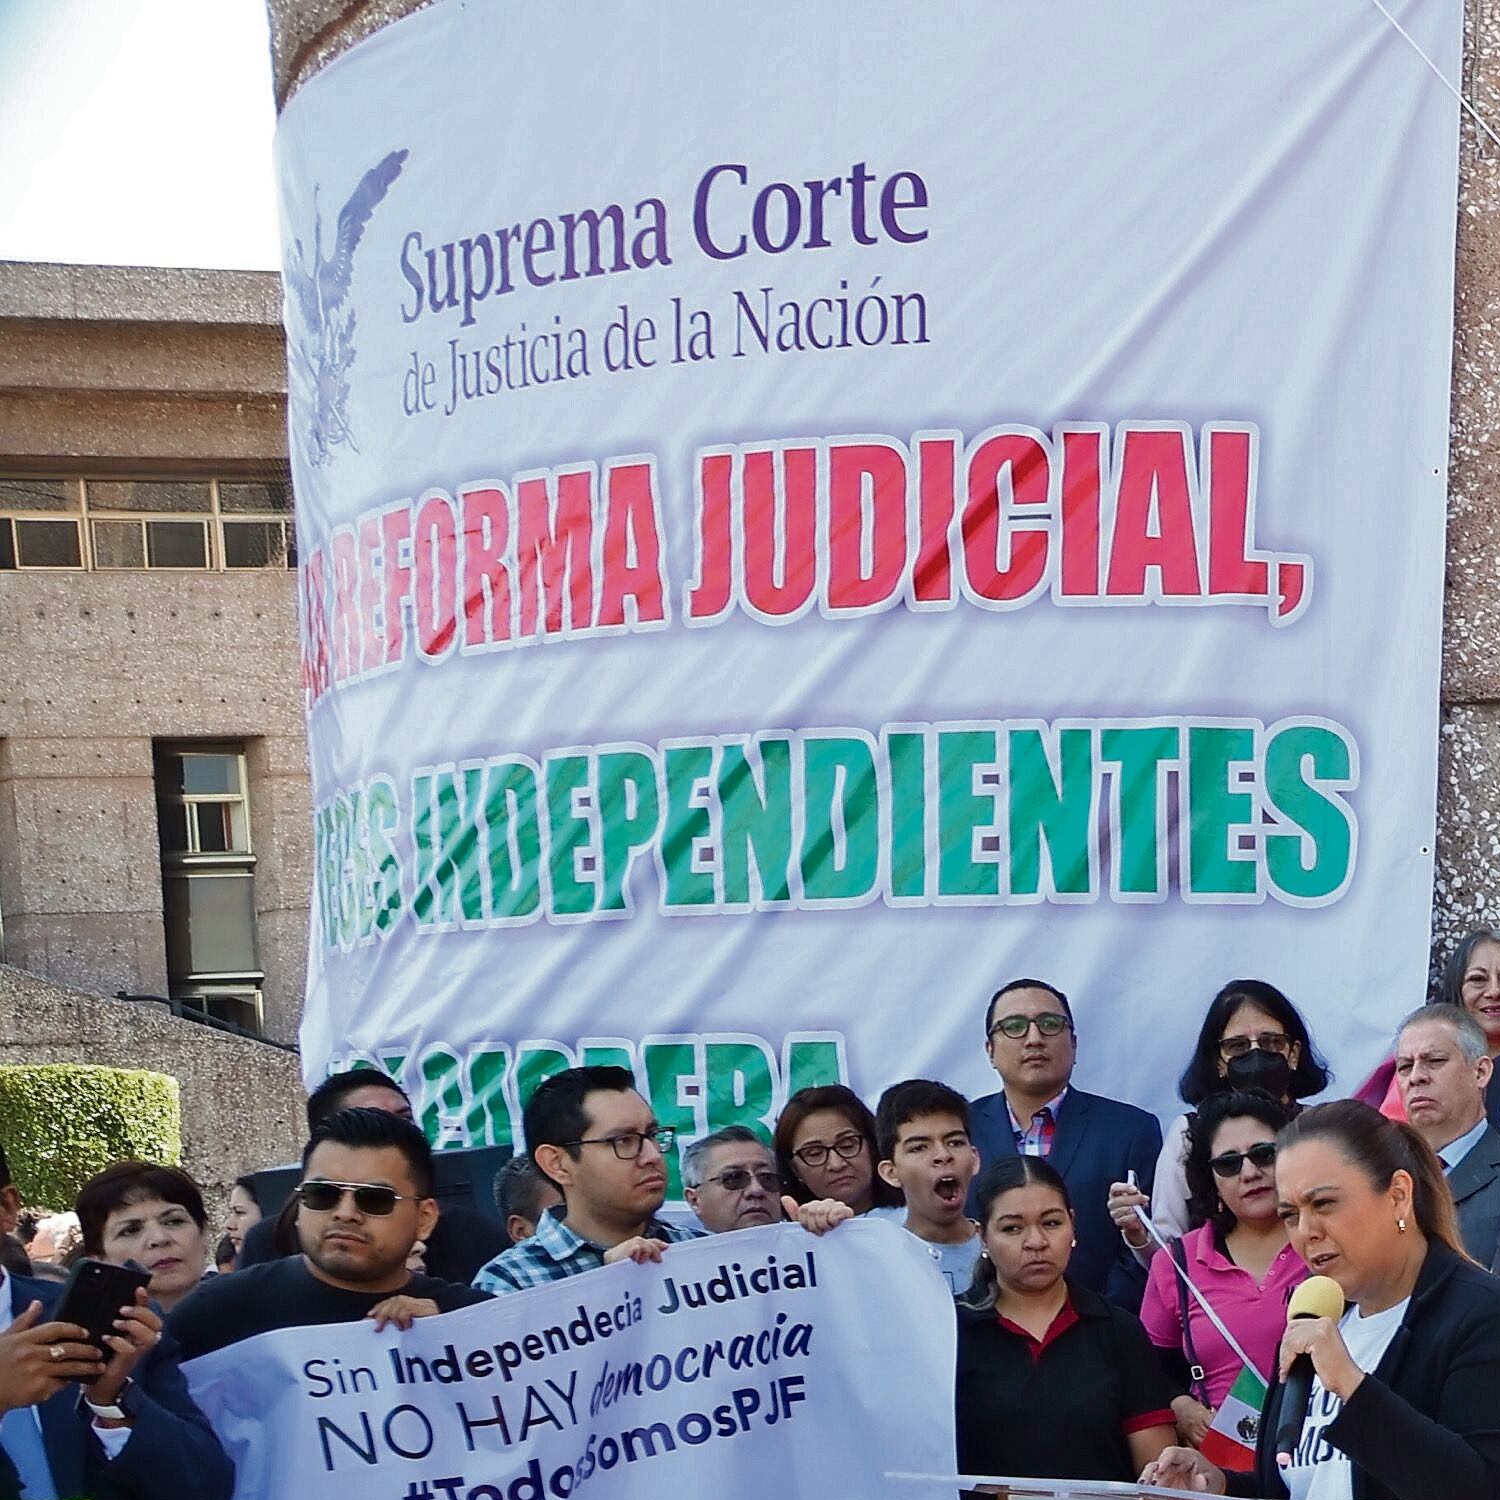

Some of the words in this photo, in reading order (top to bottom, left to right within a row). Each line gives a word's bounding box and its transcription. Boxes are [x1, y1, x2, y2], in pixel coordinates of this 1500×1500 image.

[401, 195, 670, 327] Suprema
[692, 159, 931, 262] Corte
[403, 353, 437, 418] de
[442, 310, 592, 415] Justicia
[601, 304, 658, 376] de
[670, 293, 714, 362] la
[733, 273, 931, 357] Nación
[331, 463, 666, 683] REFORMA
[688, 428, 1308, 625] JUDICIAL,
[411, 724, 1358, 928] INDEPENDIENTES
[303, 1359, 378, 1398] Sin
[657, 1250, 818, 1316] Judicial
[317, 1403, 433, 1471] NO
[460, 1370, 578, 1452] HAY
[590, 1312, 812, 1418] democracia
